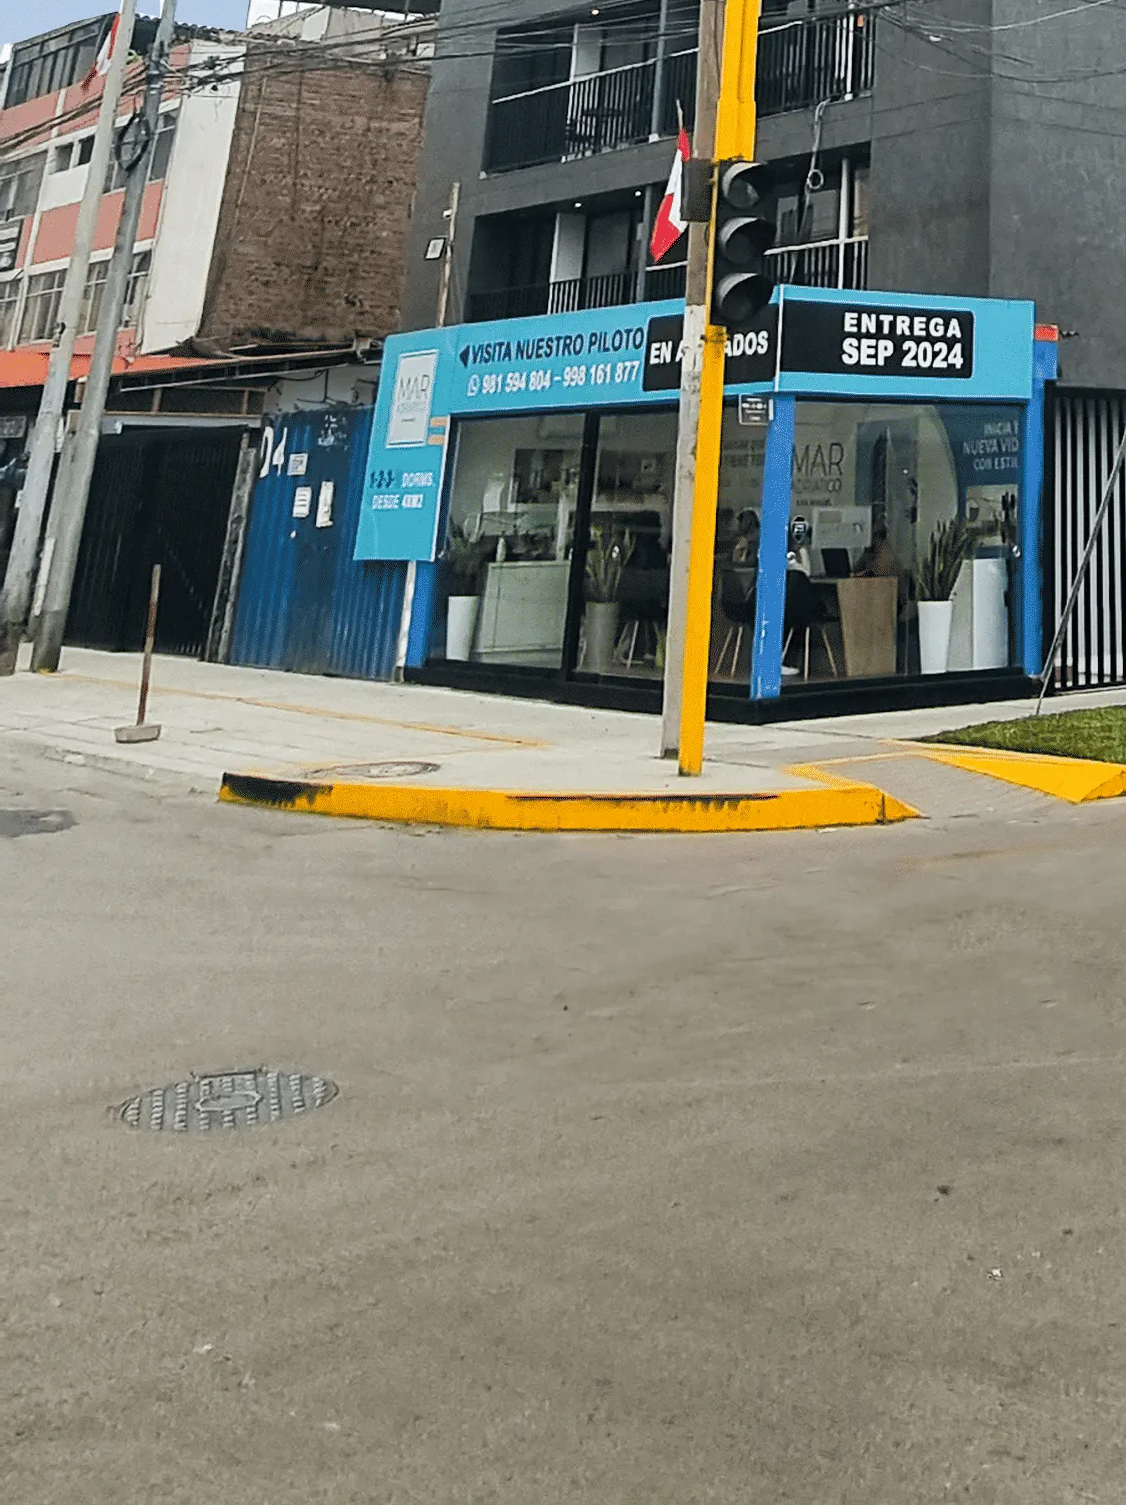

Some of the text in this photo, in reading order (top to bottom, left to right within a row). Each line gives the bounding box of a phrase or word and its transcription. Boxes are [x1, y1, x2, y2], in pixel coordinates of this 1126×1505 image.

[843, 311, 962, 339] ENTREGA
[472, 326, 645, 365] VISITA NUESTRO PILOTO
[649, 330, 769, 365] EN AADOS
[841, 338, 964, 370] SEP 2024
[504, 371, 527, 393] 594
[528, 369, 551, 392] 804
[562, 364, 587, 388] 998
[589, 361, 612, 386] 161
[614, 359, 641, 384] 877
[792, 442, 846, 477] MAR
[1000, 436, 1020, 454] VID
